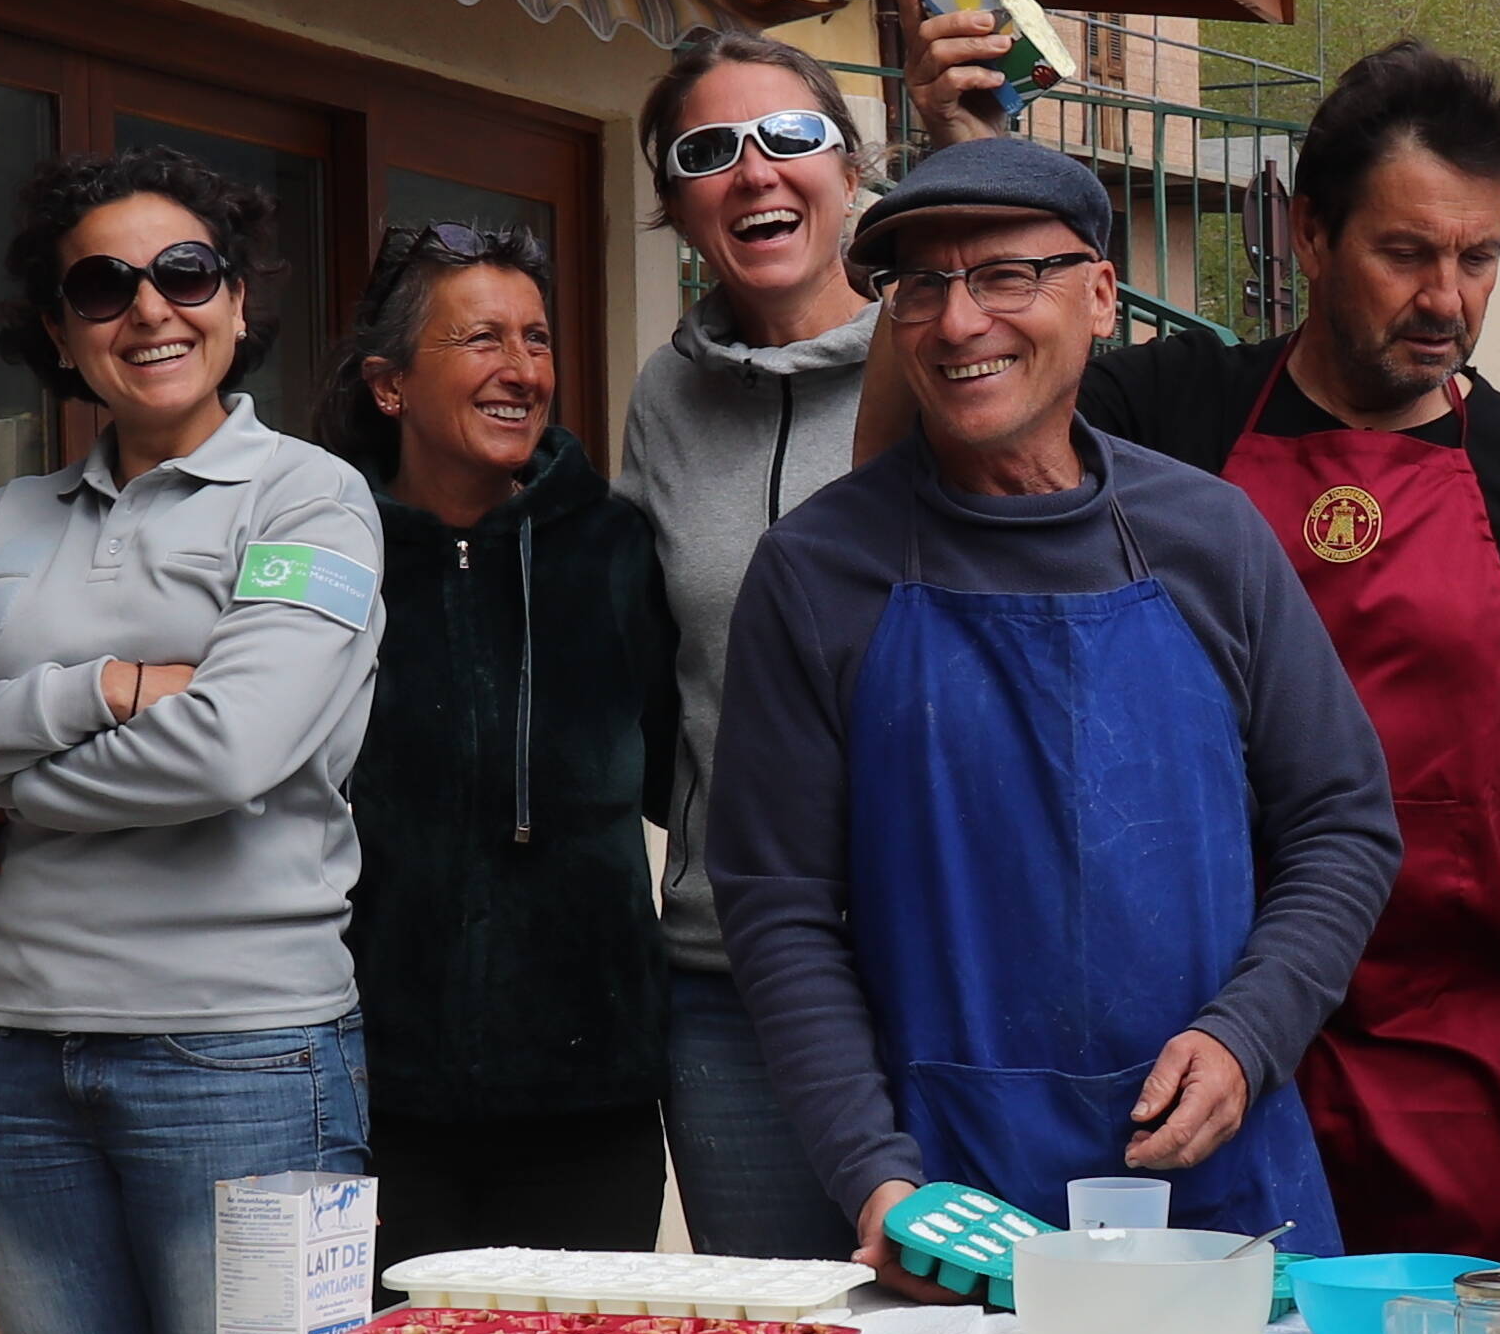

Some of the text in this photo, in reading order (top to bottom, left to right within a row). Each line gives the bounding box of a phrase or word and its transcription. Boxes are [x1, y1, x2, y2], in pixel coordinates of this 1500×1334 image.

[308, 569, 368, 599] Mercantour
[307, 1241, 368, 1277] LAIT DE
[307, 1272, 366, 1303] MONTAGNE
